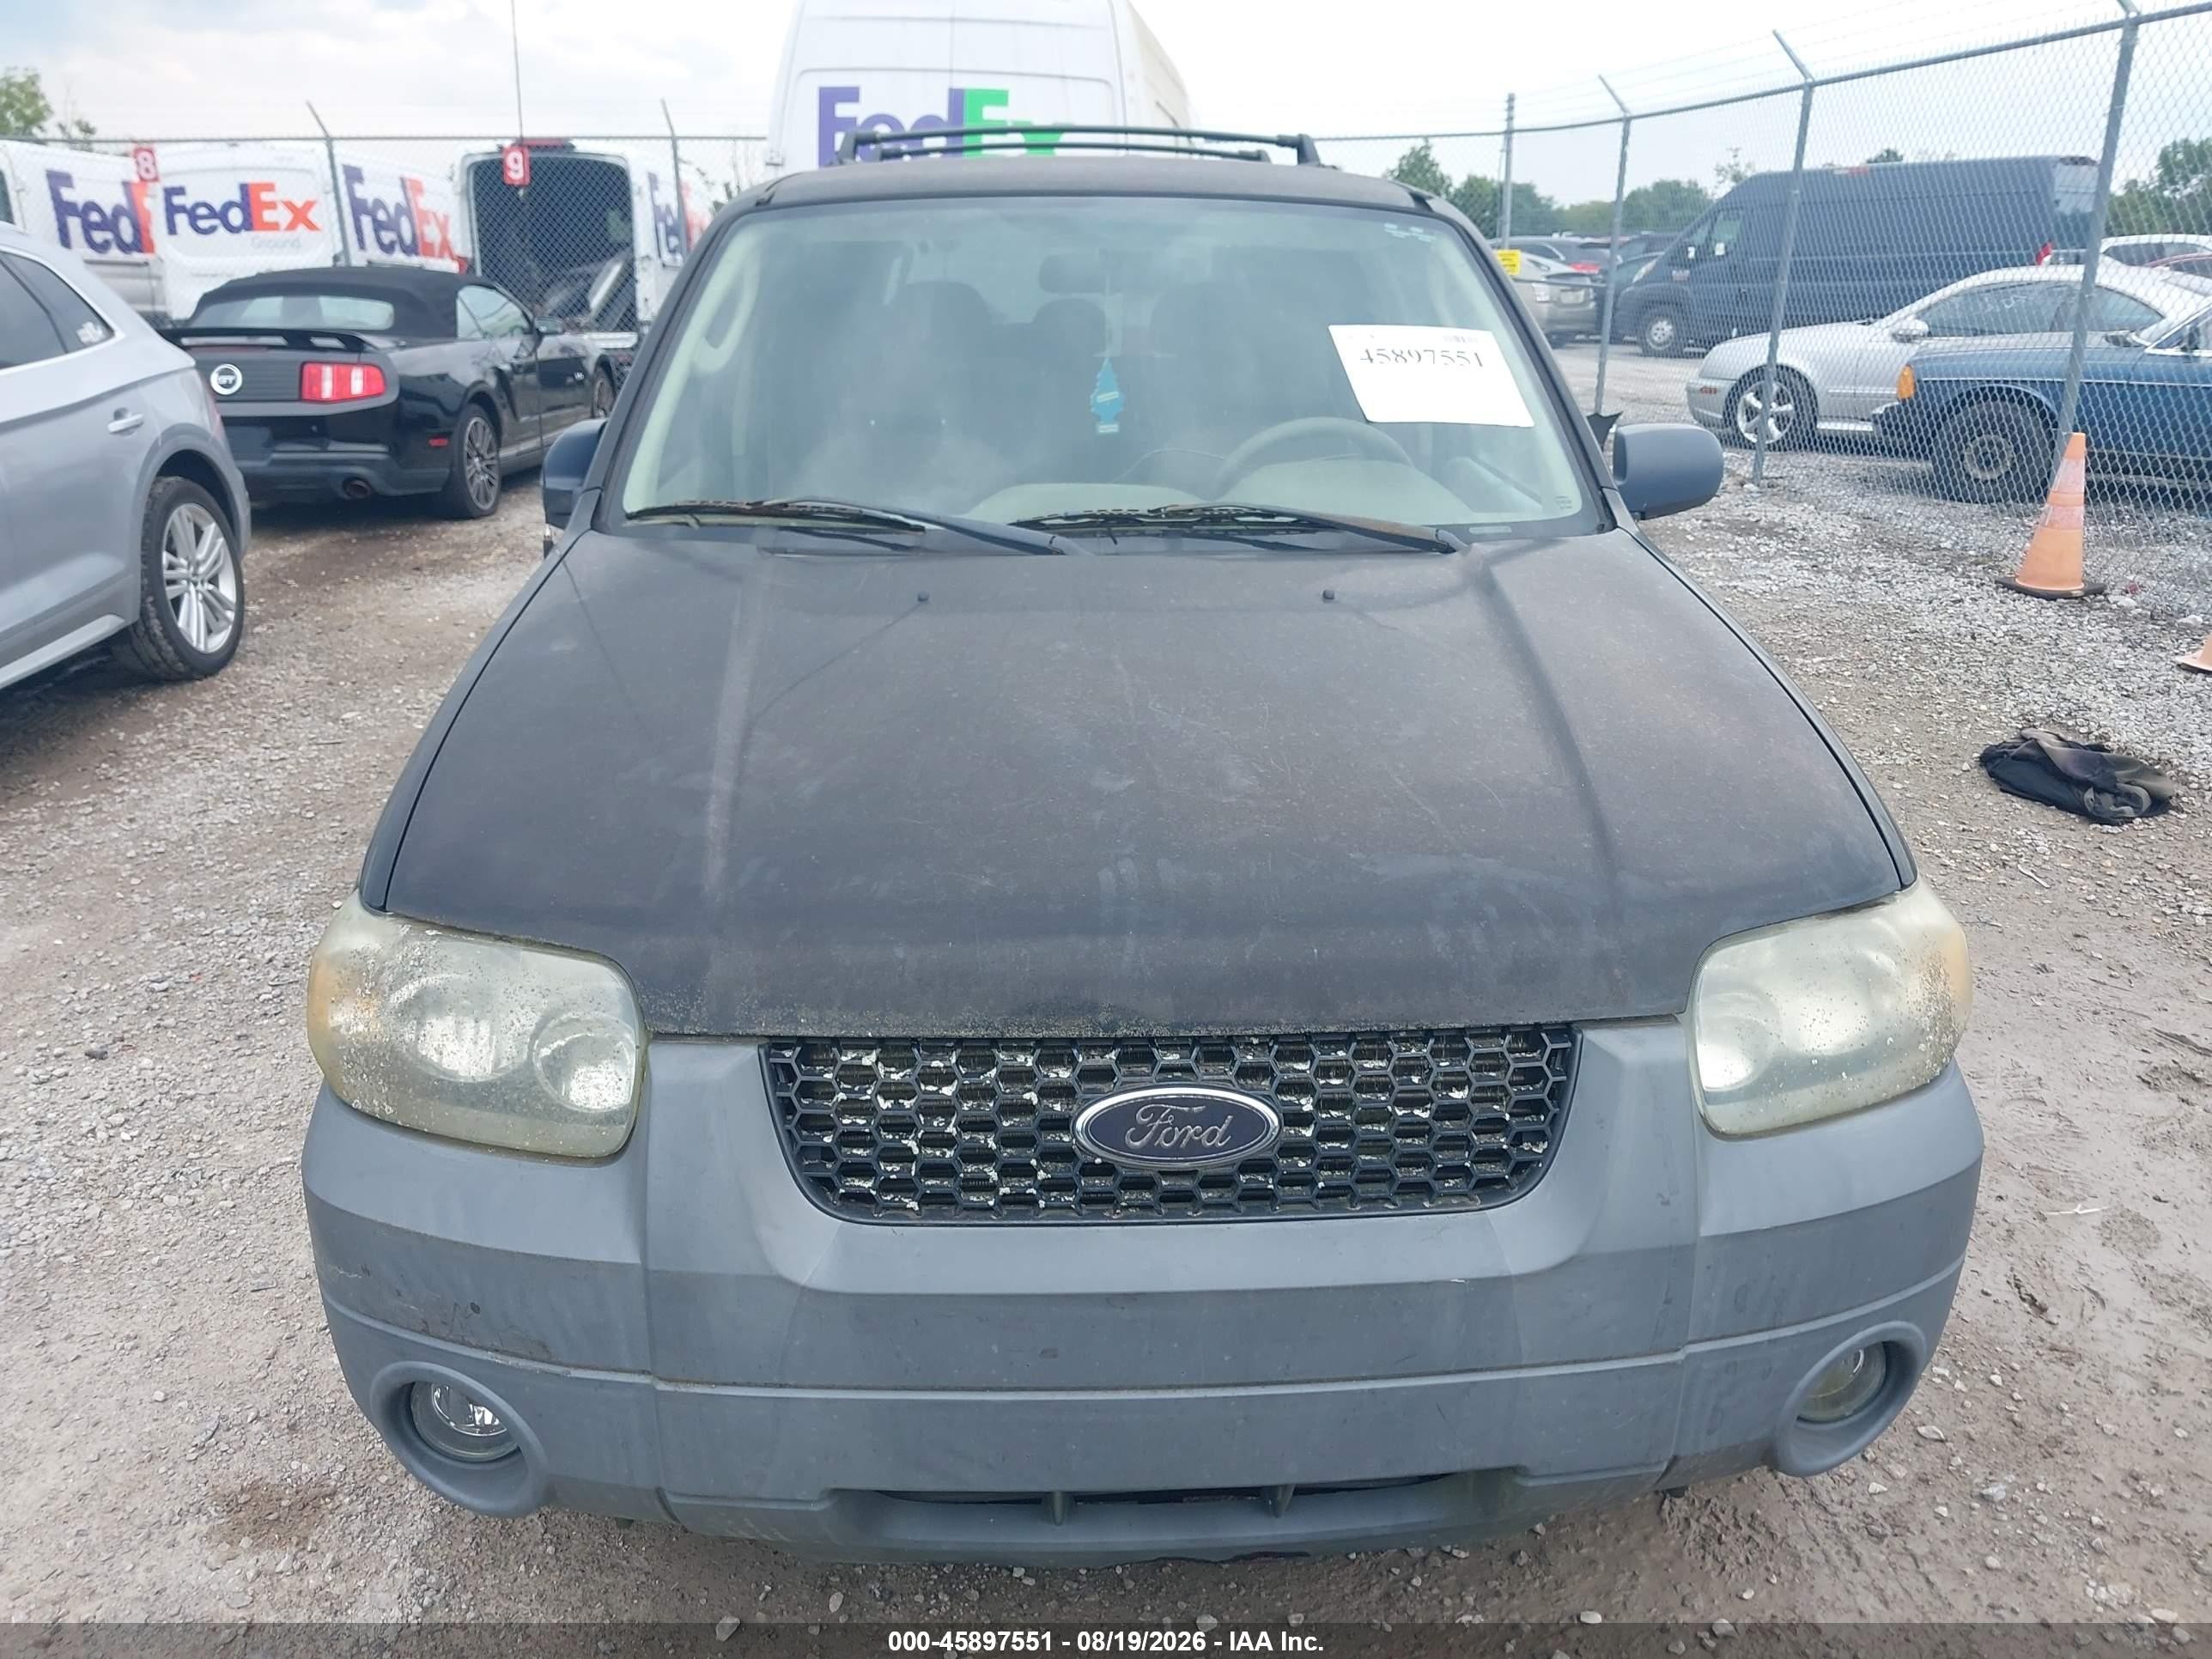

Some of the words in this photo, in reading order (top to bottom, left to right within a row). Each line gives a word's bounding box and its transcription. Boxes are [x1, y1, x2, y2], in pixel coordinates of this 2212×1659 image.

[136, 149, 158, 181] 8
[507, 151, 524, 179] 9
[164, 182, 321, 236] FedEx
[343, 164, 456, 259] FedEx
[1360, 349, 1483, 367] 45897551
[1125, 1103, 1234, 1148] Ford
